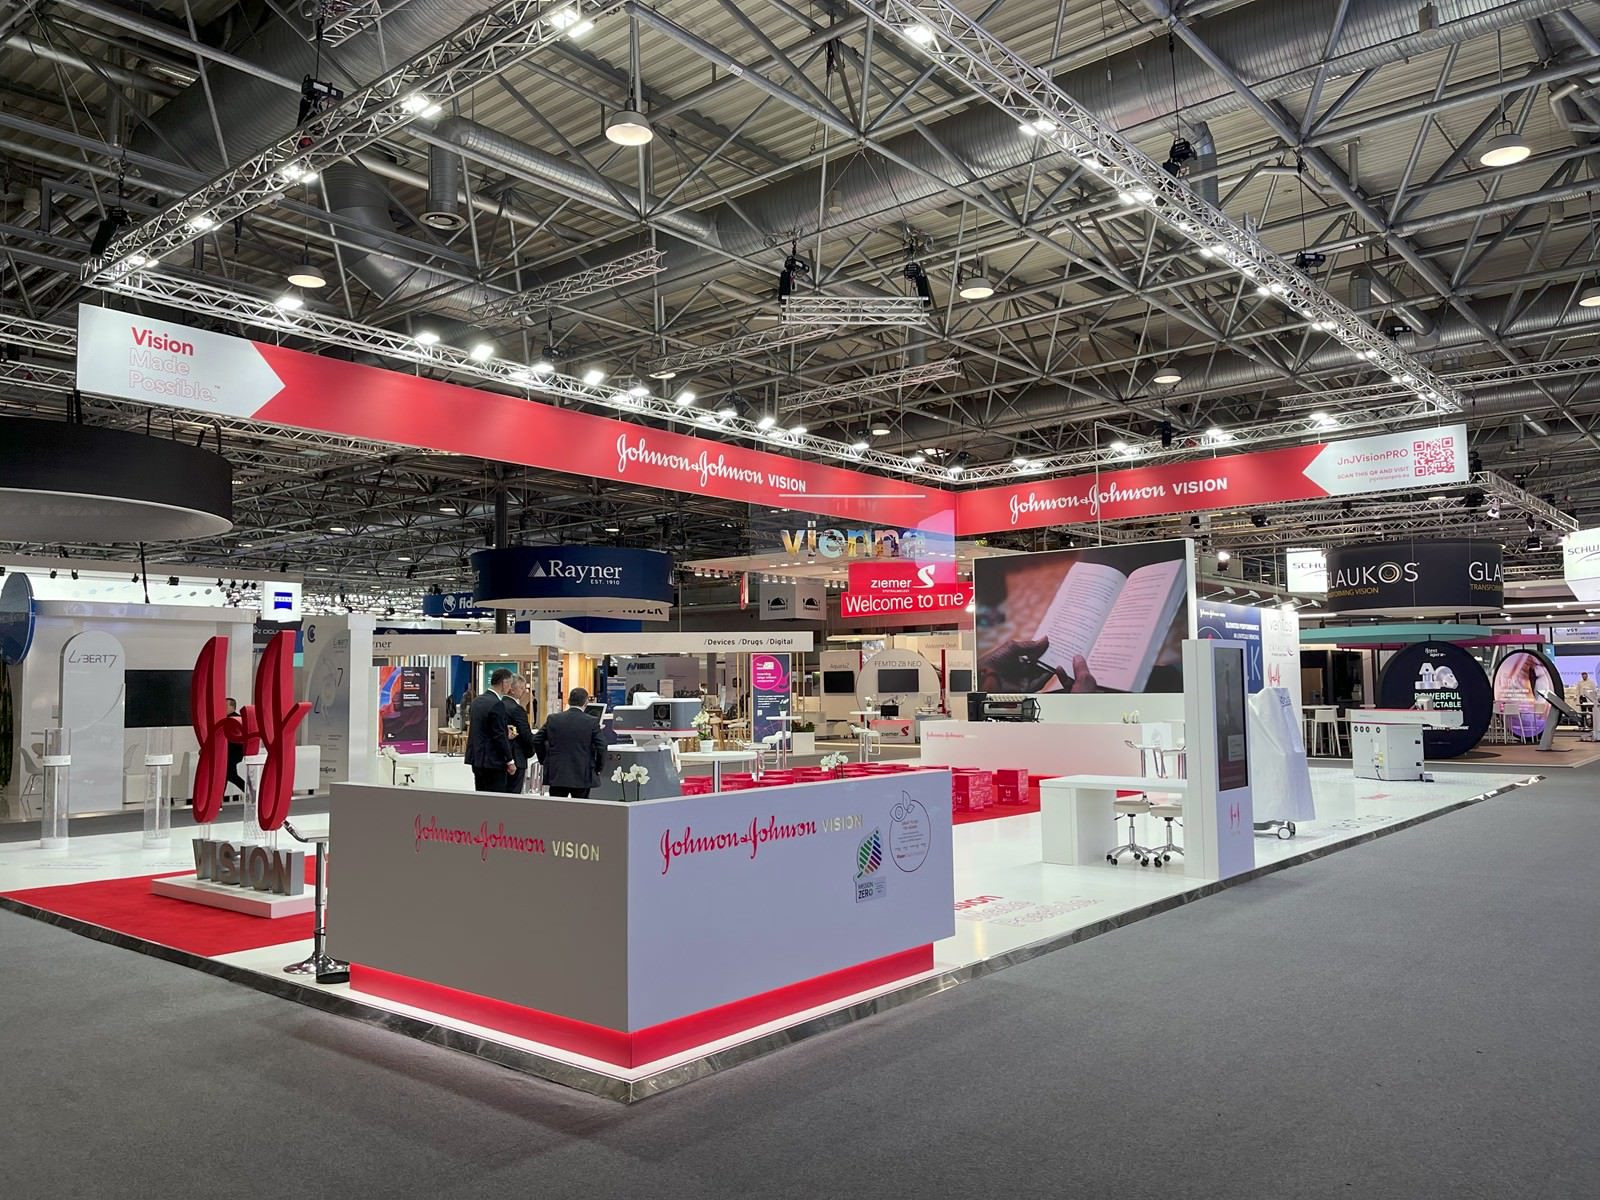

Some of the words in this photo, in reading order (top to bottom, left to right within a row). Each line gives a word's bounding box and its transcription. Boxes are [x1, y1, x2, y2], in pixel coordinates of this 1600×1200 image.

[131, 326, 194, 356] Vision
[129, 347, 190, 376] Made
[1337, 448, 1408, 466] JnJVisionPRO
[768, 473, 806, 493] VISION
[1172, 477, 1228, 495] VISION
[780, 520, 926, 558] vienna
[548, 560, 623, 584] Rayner
[870, 579, 912, 589] ziemer
[1354, 586, 1379, 595] VISION
[845, 595, 913, 613] Welcome
[917, 594, 933, 608] to
[373, 640, 392, 648] ner
[821, 814, 863, 833] VISION
[552, 840, 600, 861] VISION
[192, 839, 304, 895] VISION
[858, 888, 874, 899] ZERO
